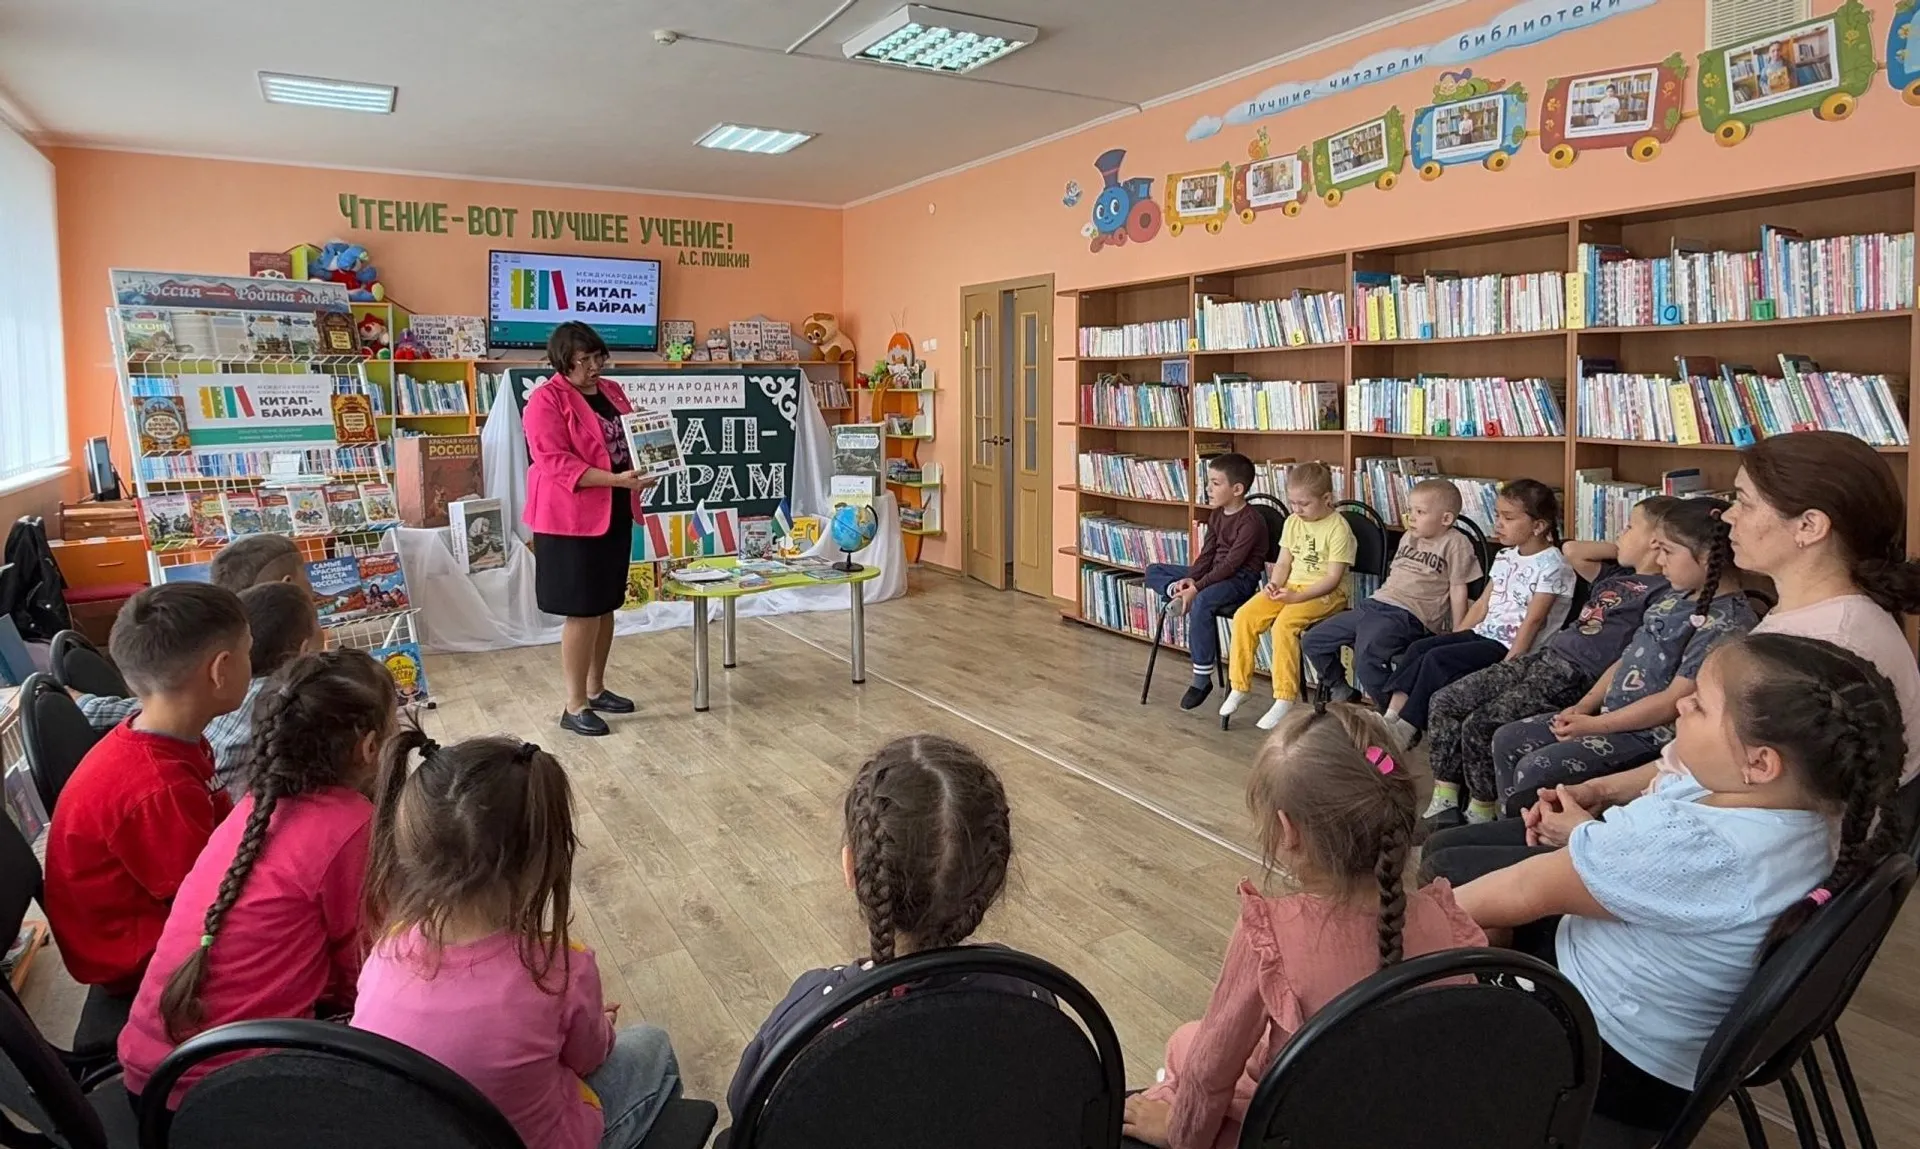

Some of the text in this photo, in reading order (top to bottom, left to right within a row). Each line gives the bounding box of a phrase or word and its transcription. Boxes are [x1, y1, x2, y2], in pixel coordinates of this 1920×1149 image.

[1247, 0, 1621, 116] Лучшие читатели библиотеки
[531, 209, 629, 243] ЛУЧШЕЕ
[639, 216, 734, 249] УЧЕНИЕ!
[136, 282, 202, 298] Россия
[234, 287, 295, 303] Родина
[576, 286, 638, 299] КИТАП-
[576, 299, 646, 314] БАЙРАМ
[259, 396, 314, 406] КИТАП-
[631, 395, 738, 405] ЖНАЯ ЯРМАРКА
[261, 406, 324, 418] БАЙРАМ
[676, 416, 778, 455] АП-
[428, 444, 479, 456] РОССИИ
[310, 564, 354, 576] КРАСИВЫЕ
[312, 560, 342, 570] САМЫЕ
[321, 572, 348, 580] МЕСТА
